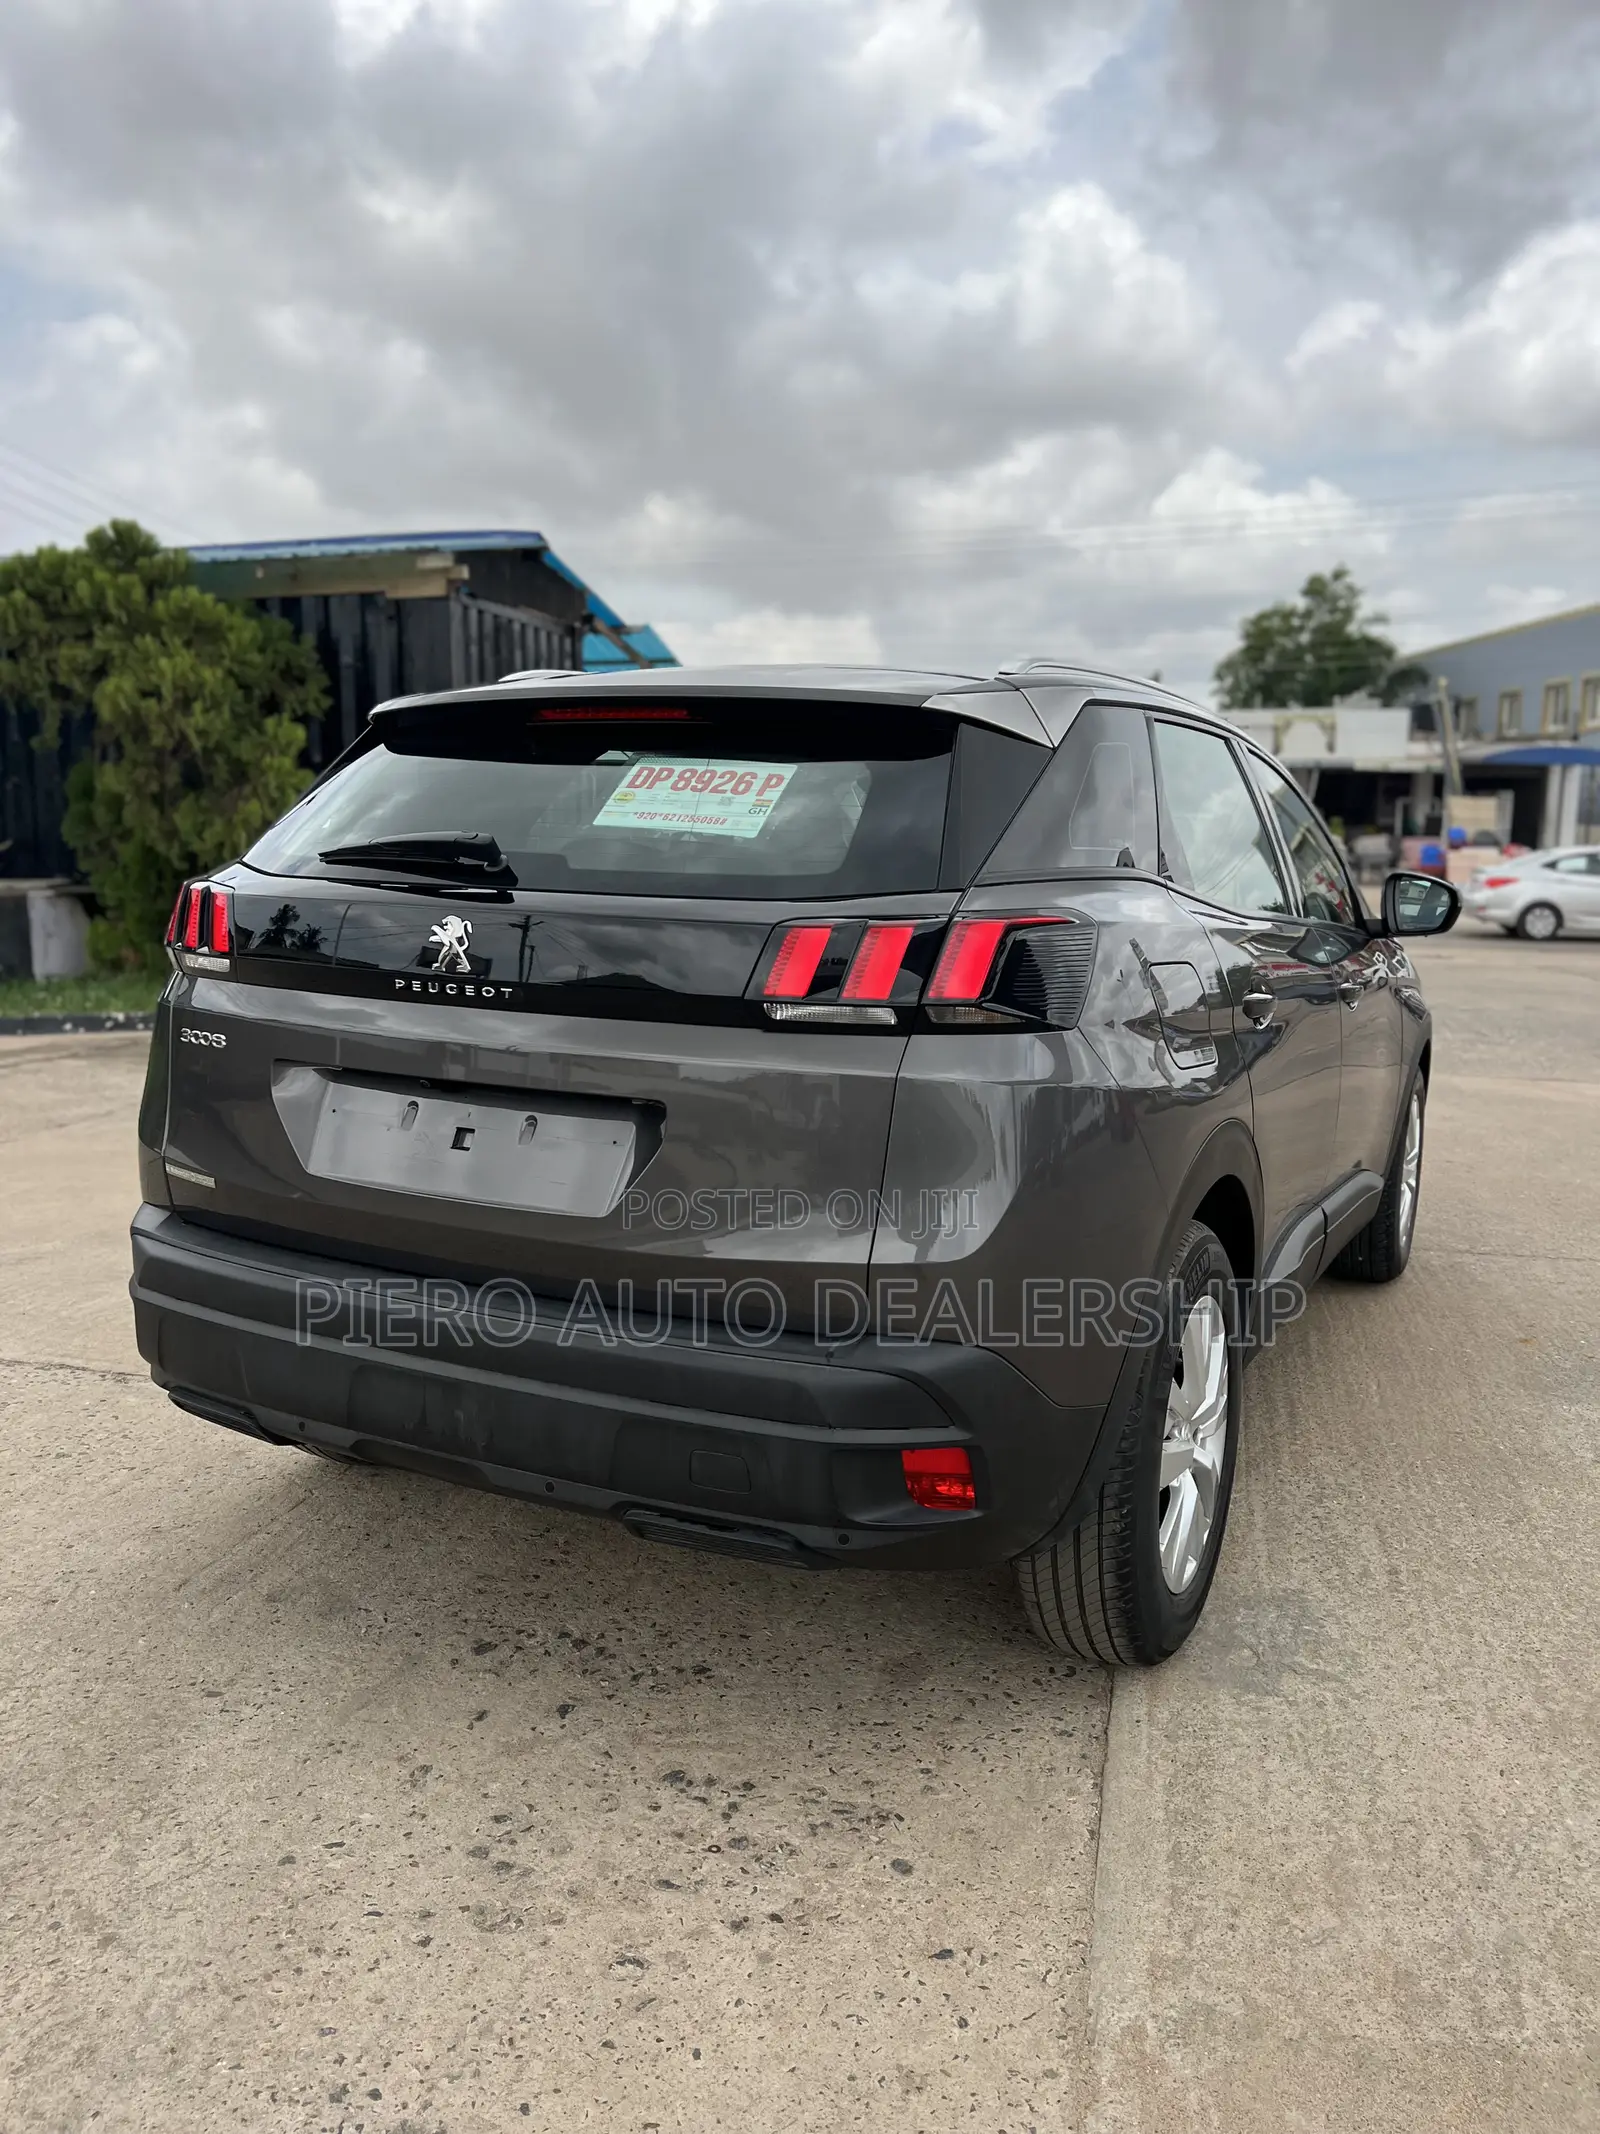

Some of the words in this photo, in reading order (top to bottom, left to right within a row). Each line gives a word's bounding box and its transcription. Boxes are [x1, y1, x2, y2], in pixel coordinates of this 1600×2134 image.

[625, 766, 676, 790] DP
[670, 768, 758, 796] 8926
[755, 772, 785, 797] P
[748, 807, 768, 816] GH
[394, 979, 513, 999] PEUGEOT
[180, 1027, 227, 1049] 3008
